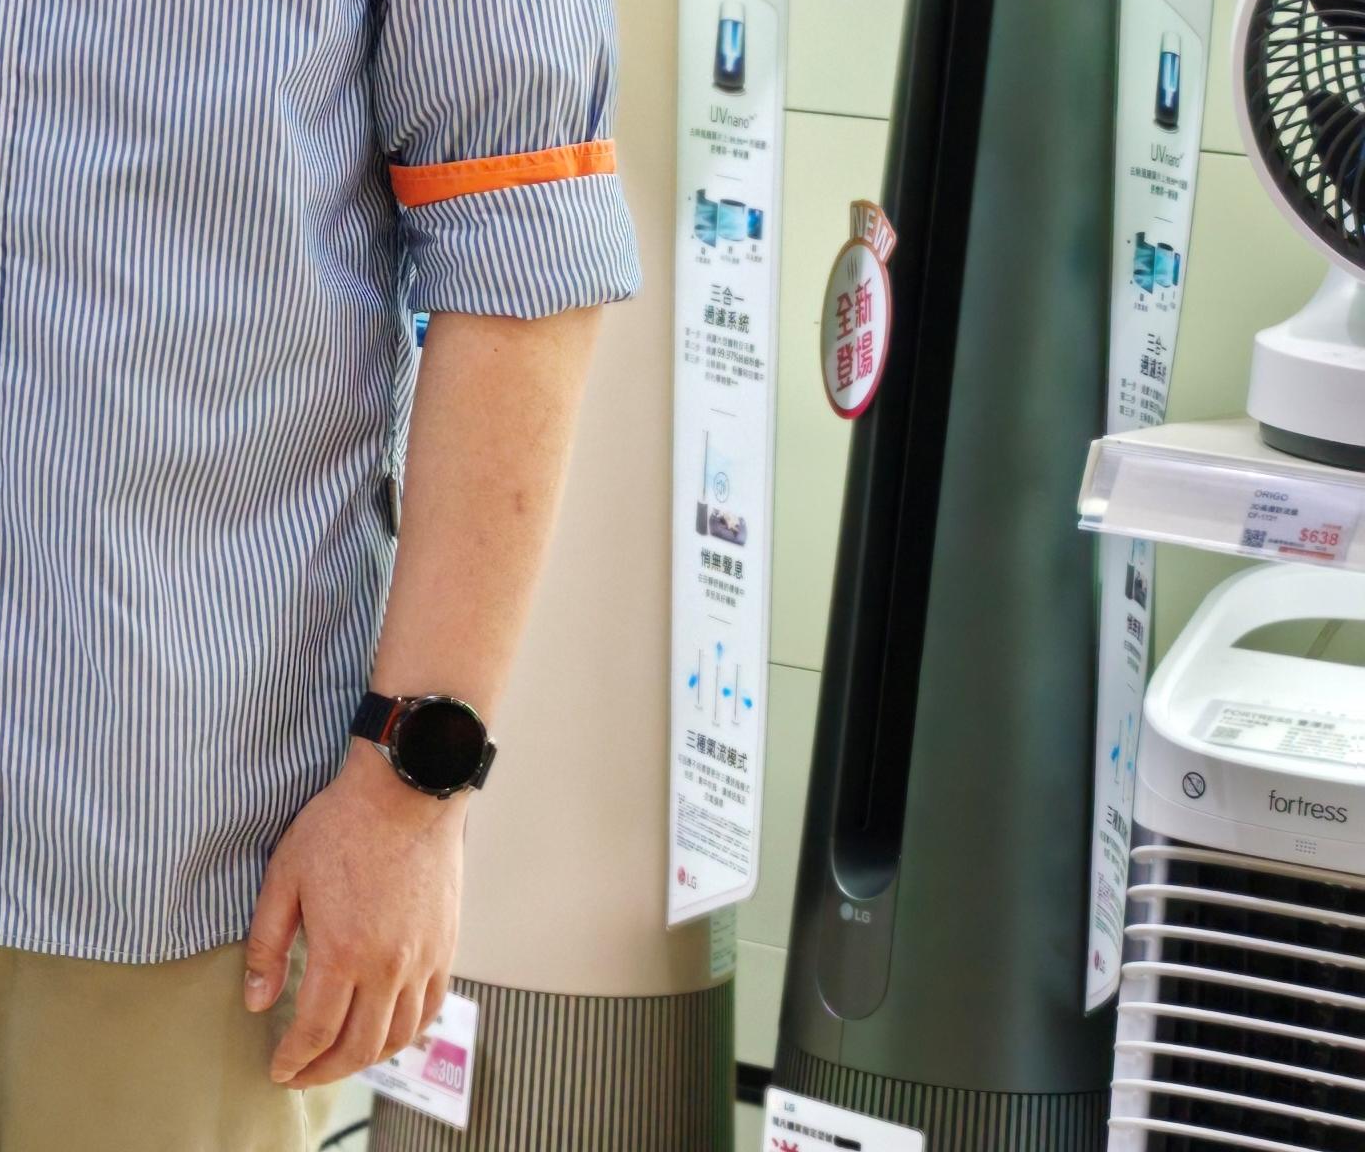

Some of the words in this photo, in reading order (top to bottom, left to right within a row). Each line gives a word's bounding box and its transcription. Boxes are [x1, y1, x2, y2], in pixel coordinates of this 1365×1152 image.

[853, 204, 893, 263] NEW
[710, 283, 745, 306] 三合一
[704, 304, 750, 334] 過濾系統
[1254, 489, 1289, 502] ORIGO
[1299, 527, 1339, 546] $638
[1223, 709, 1293, 724] FORTRESS
[1269, 790, 1348, 824] fortress
[686, 872, 698, 890] LG
[854, 908, 871, 924] LG
[784, 1102, 795, 1113] LG
